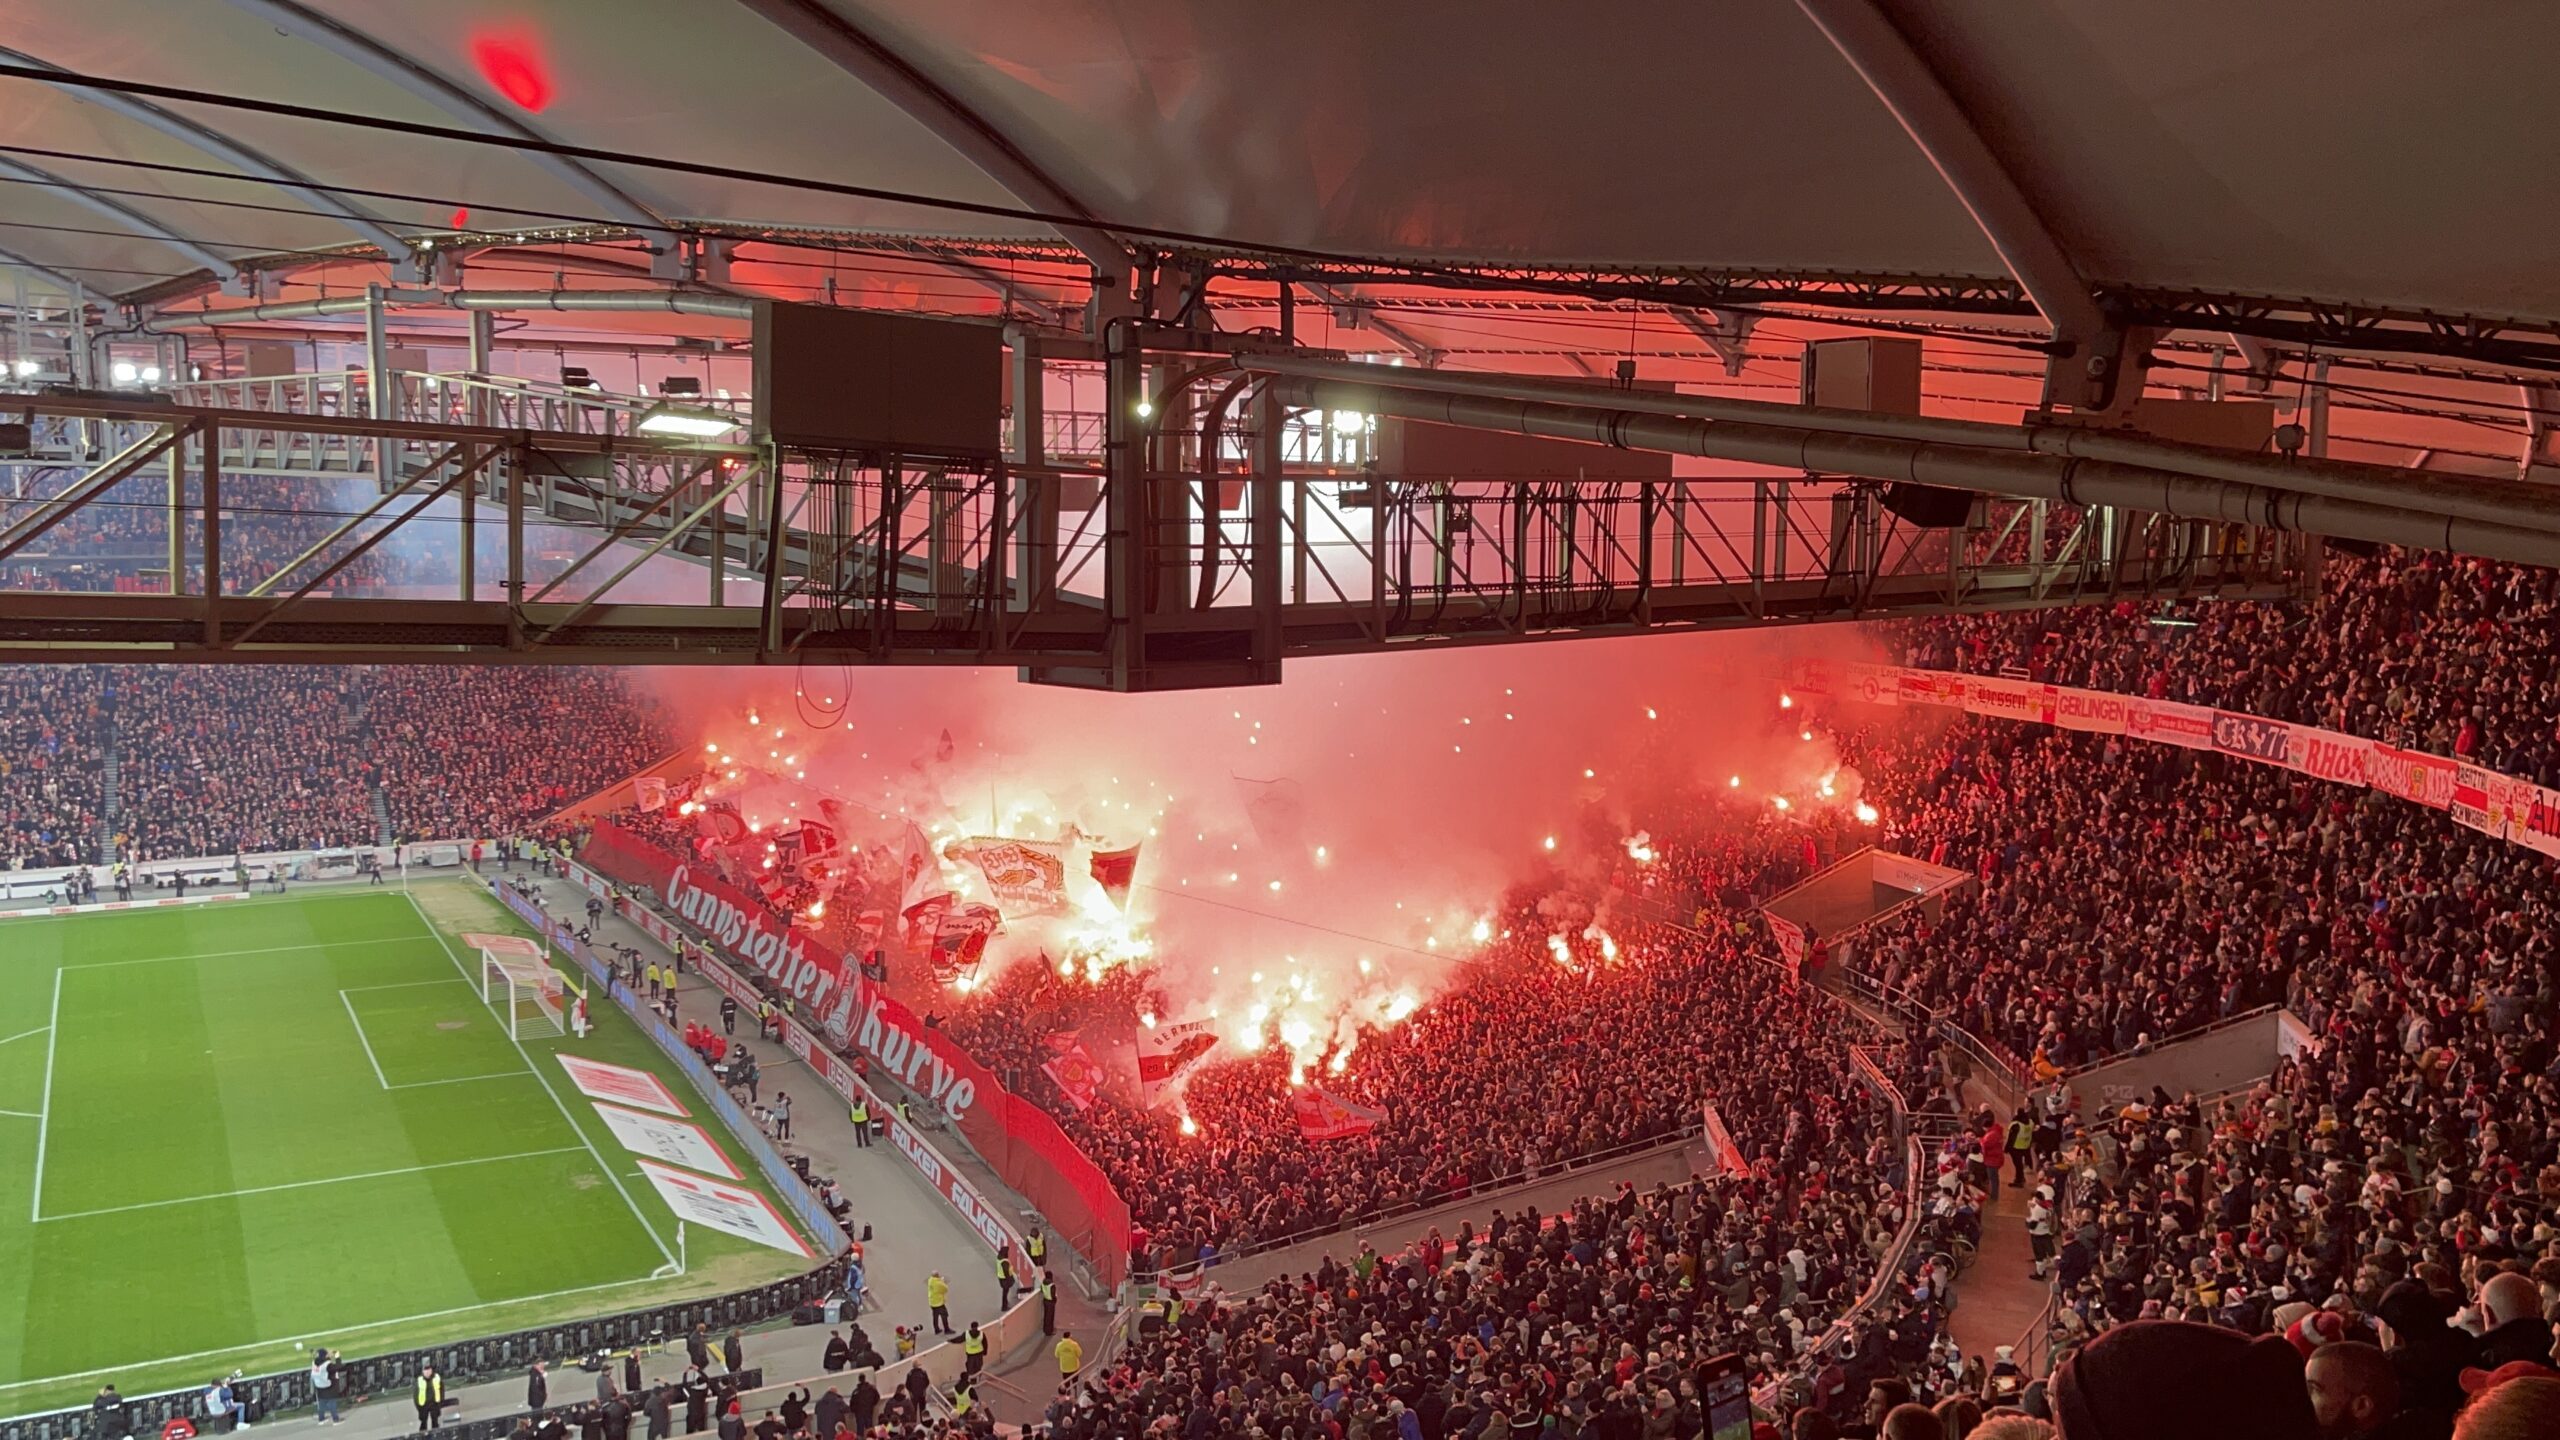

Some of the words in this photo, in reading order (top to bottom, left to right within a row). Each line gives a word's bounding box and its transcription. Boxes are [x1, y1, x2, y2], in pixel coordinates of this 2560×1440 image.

[2058, 695, 2125, 722] GERLINGEN
[2266, 726, 2289, 761] 77
[2305, 738, 2370, 787] RHÖN
[667, 863, 835, 1008] Cannstatter
[859, 989, 976, 1121] Kurve
[890, 1121, 942, 1187] FALKEN
[951, 1181, 1009, 1252] FALKEN
